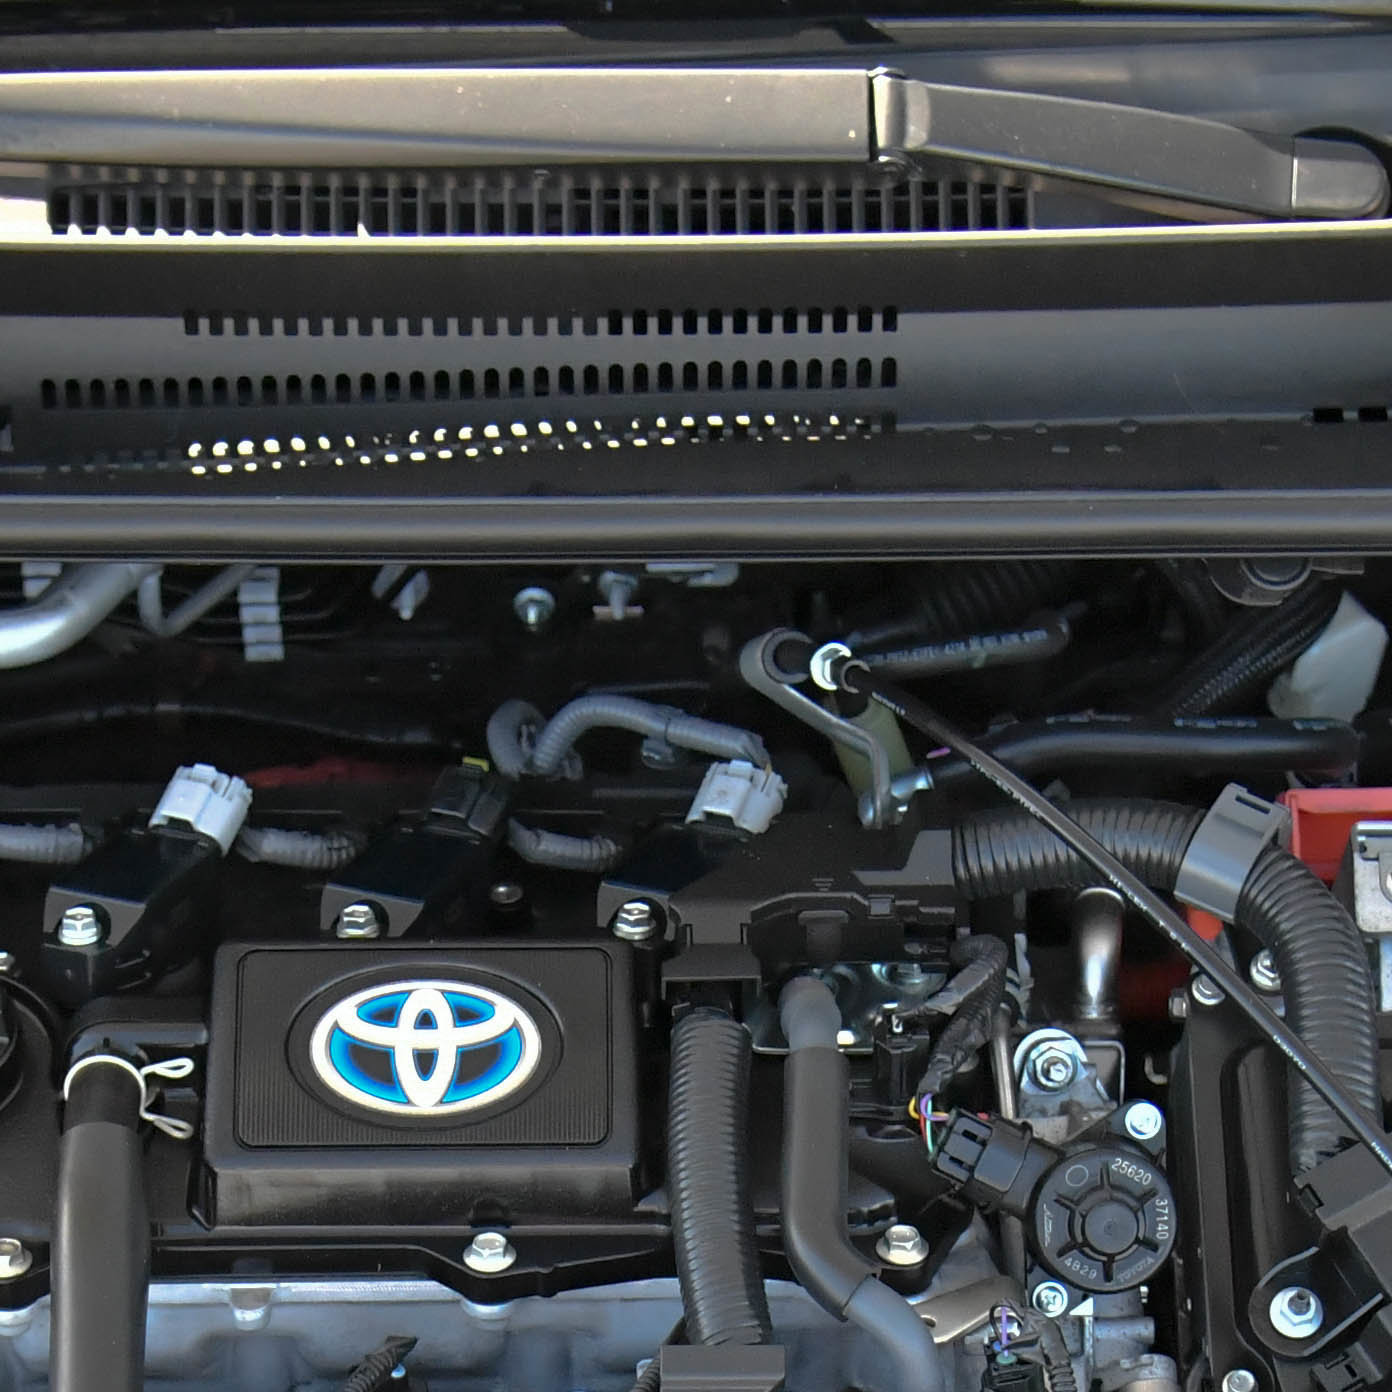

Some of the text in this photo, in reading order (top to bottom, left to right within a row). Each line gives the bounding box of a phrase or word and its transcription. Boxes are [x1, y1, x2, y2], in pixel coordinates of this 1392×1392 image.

[1111, 1157, 1152, 1185] 25620
[1155, 1198, 1169, 1240] 37140
[1117, 1256, 1156, 1283] TOYOTA
